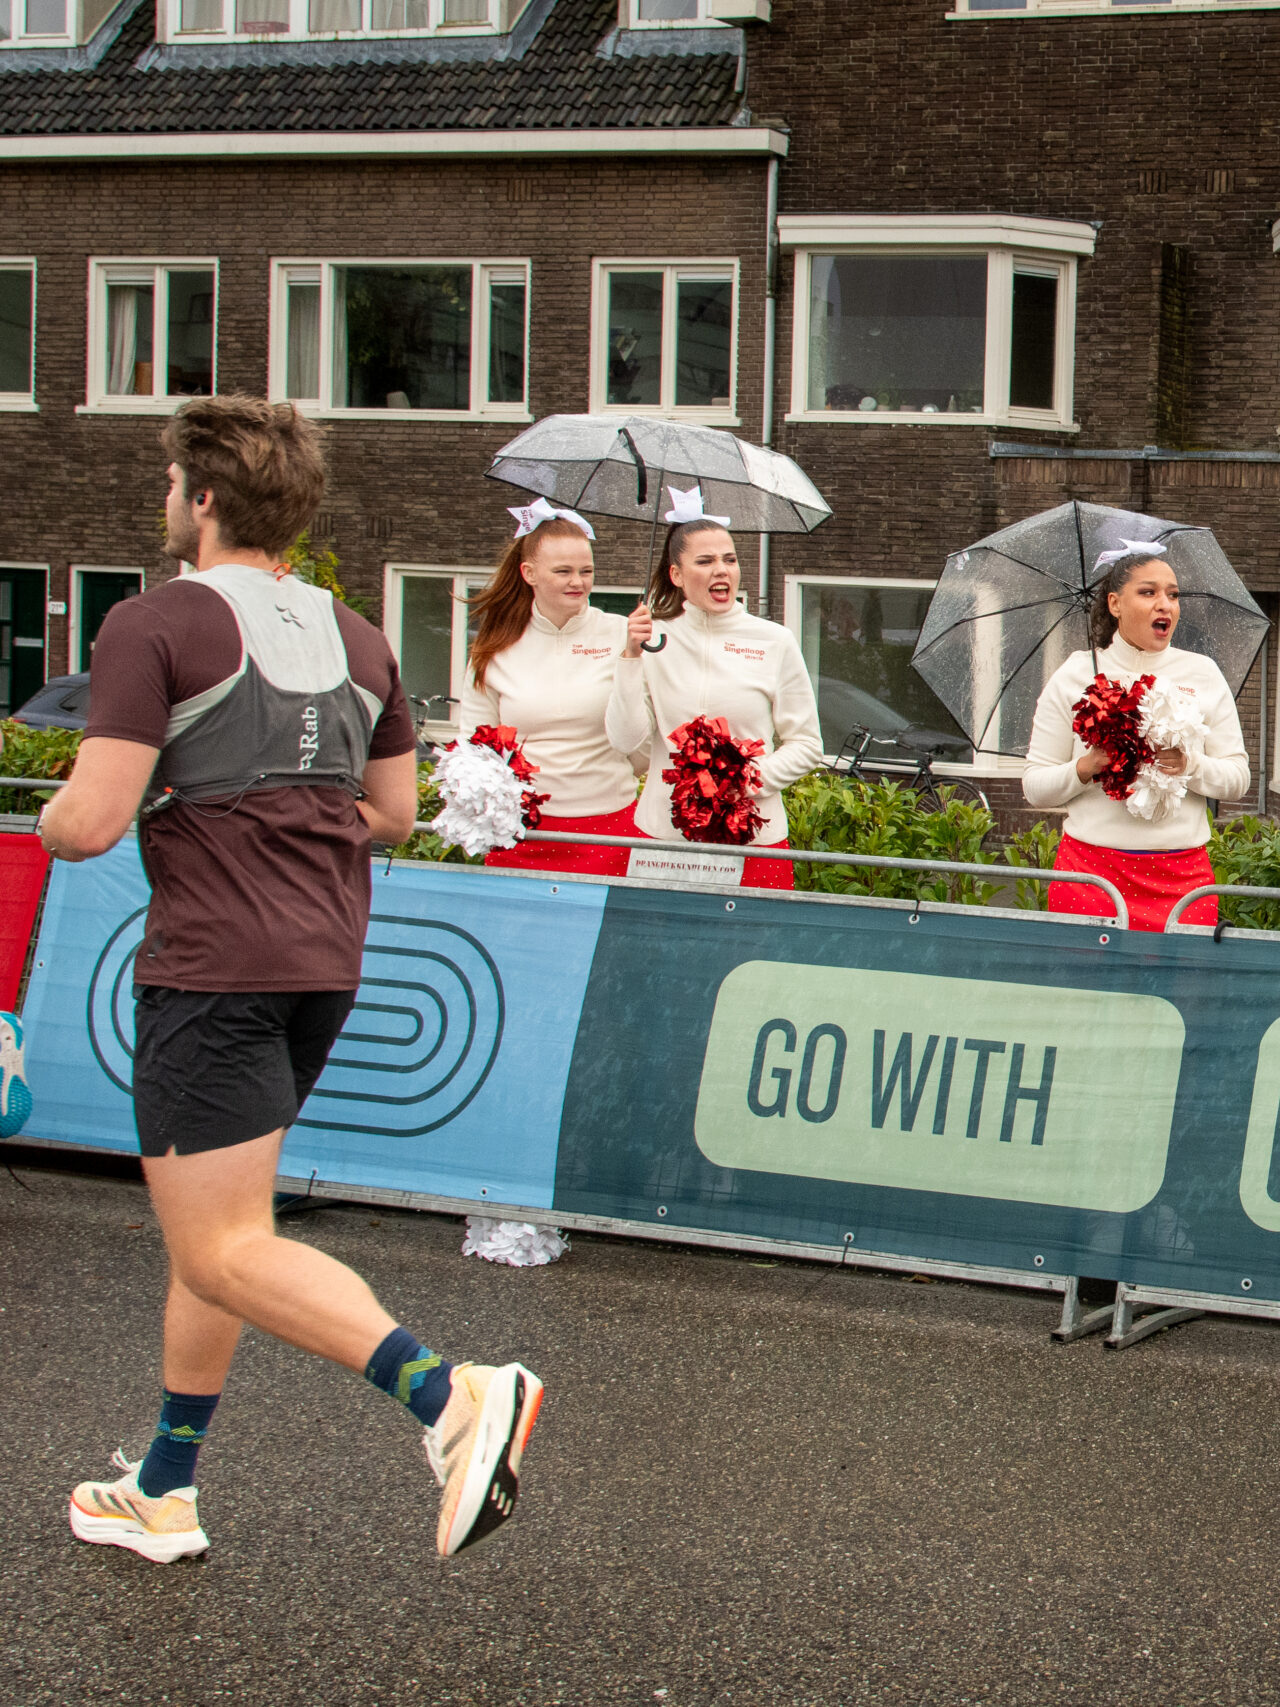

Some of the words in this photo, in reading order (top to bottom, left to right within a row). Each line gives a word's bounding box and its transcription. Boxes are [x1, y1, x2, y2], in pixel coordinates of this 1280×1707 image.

[571, 647, 611, 655] Singelloop
[723, 645, 766, 656] Singelloop
[299, 706, 319, 750] Rab
[746, 1016, 848, 1123] GO
[869, 1028, 1058, 1147] WITH
